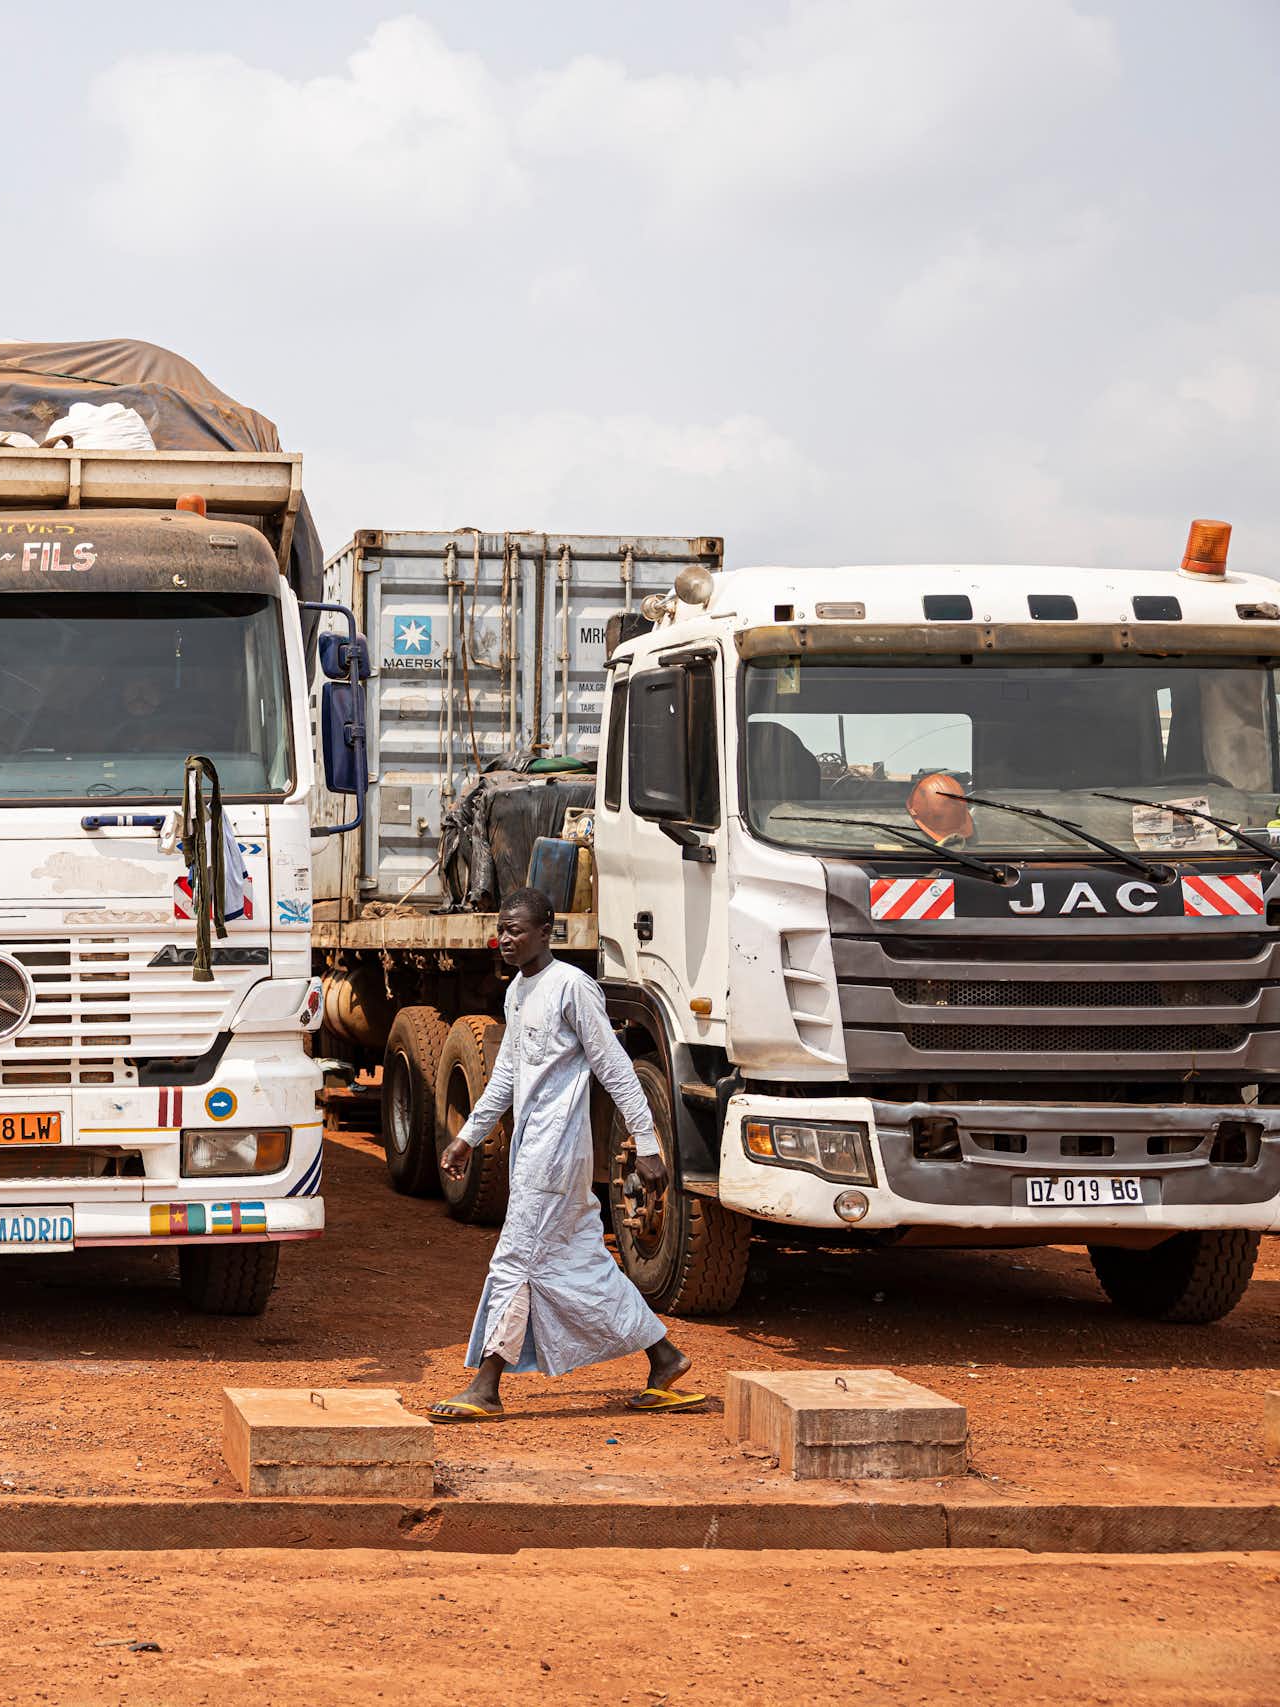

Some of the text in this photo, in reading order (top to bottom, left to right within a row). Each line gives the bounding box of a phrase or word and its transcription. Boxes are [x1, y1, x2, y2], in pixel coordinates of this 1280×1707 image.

[383, 658, 442, 668] MAERSK
[580, 703, 596, 712] TARE
[1008, 882, 1159, 915] JAC
[21, 1116, 52, 1140] LW
[1031, 1179, 1139, 1202] DZ 019 BG
